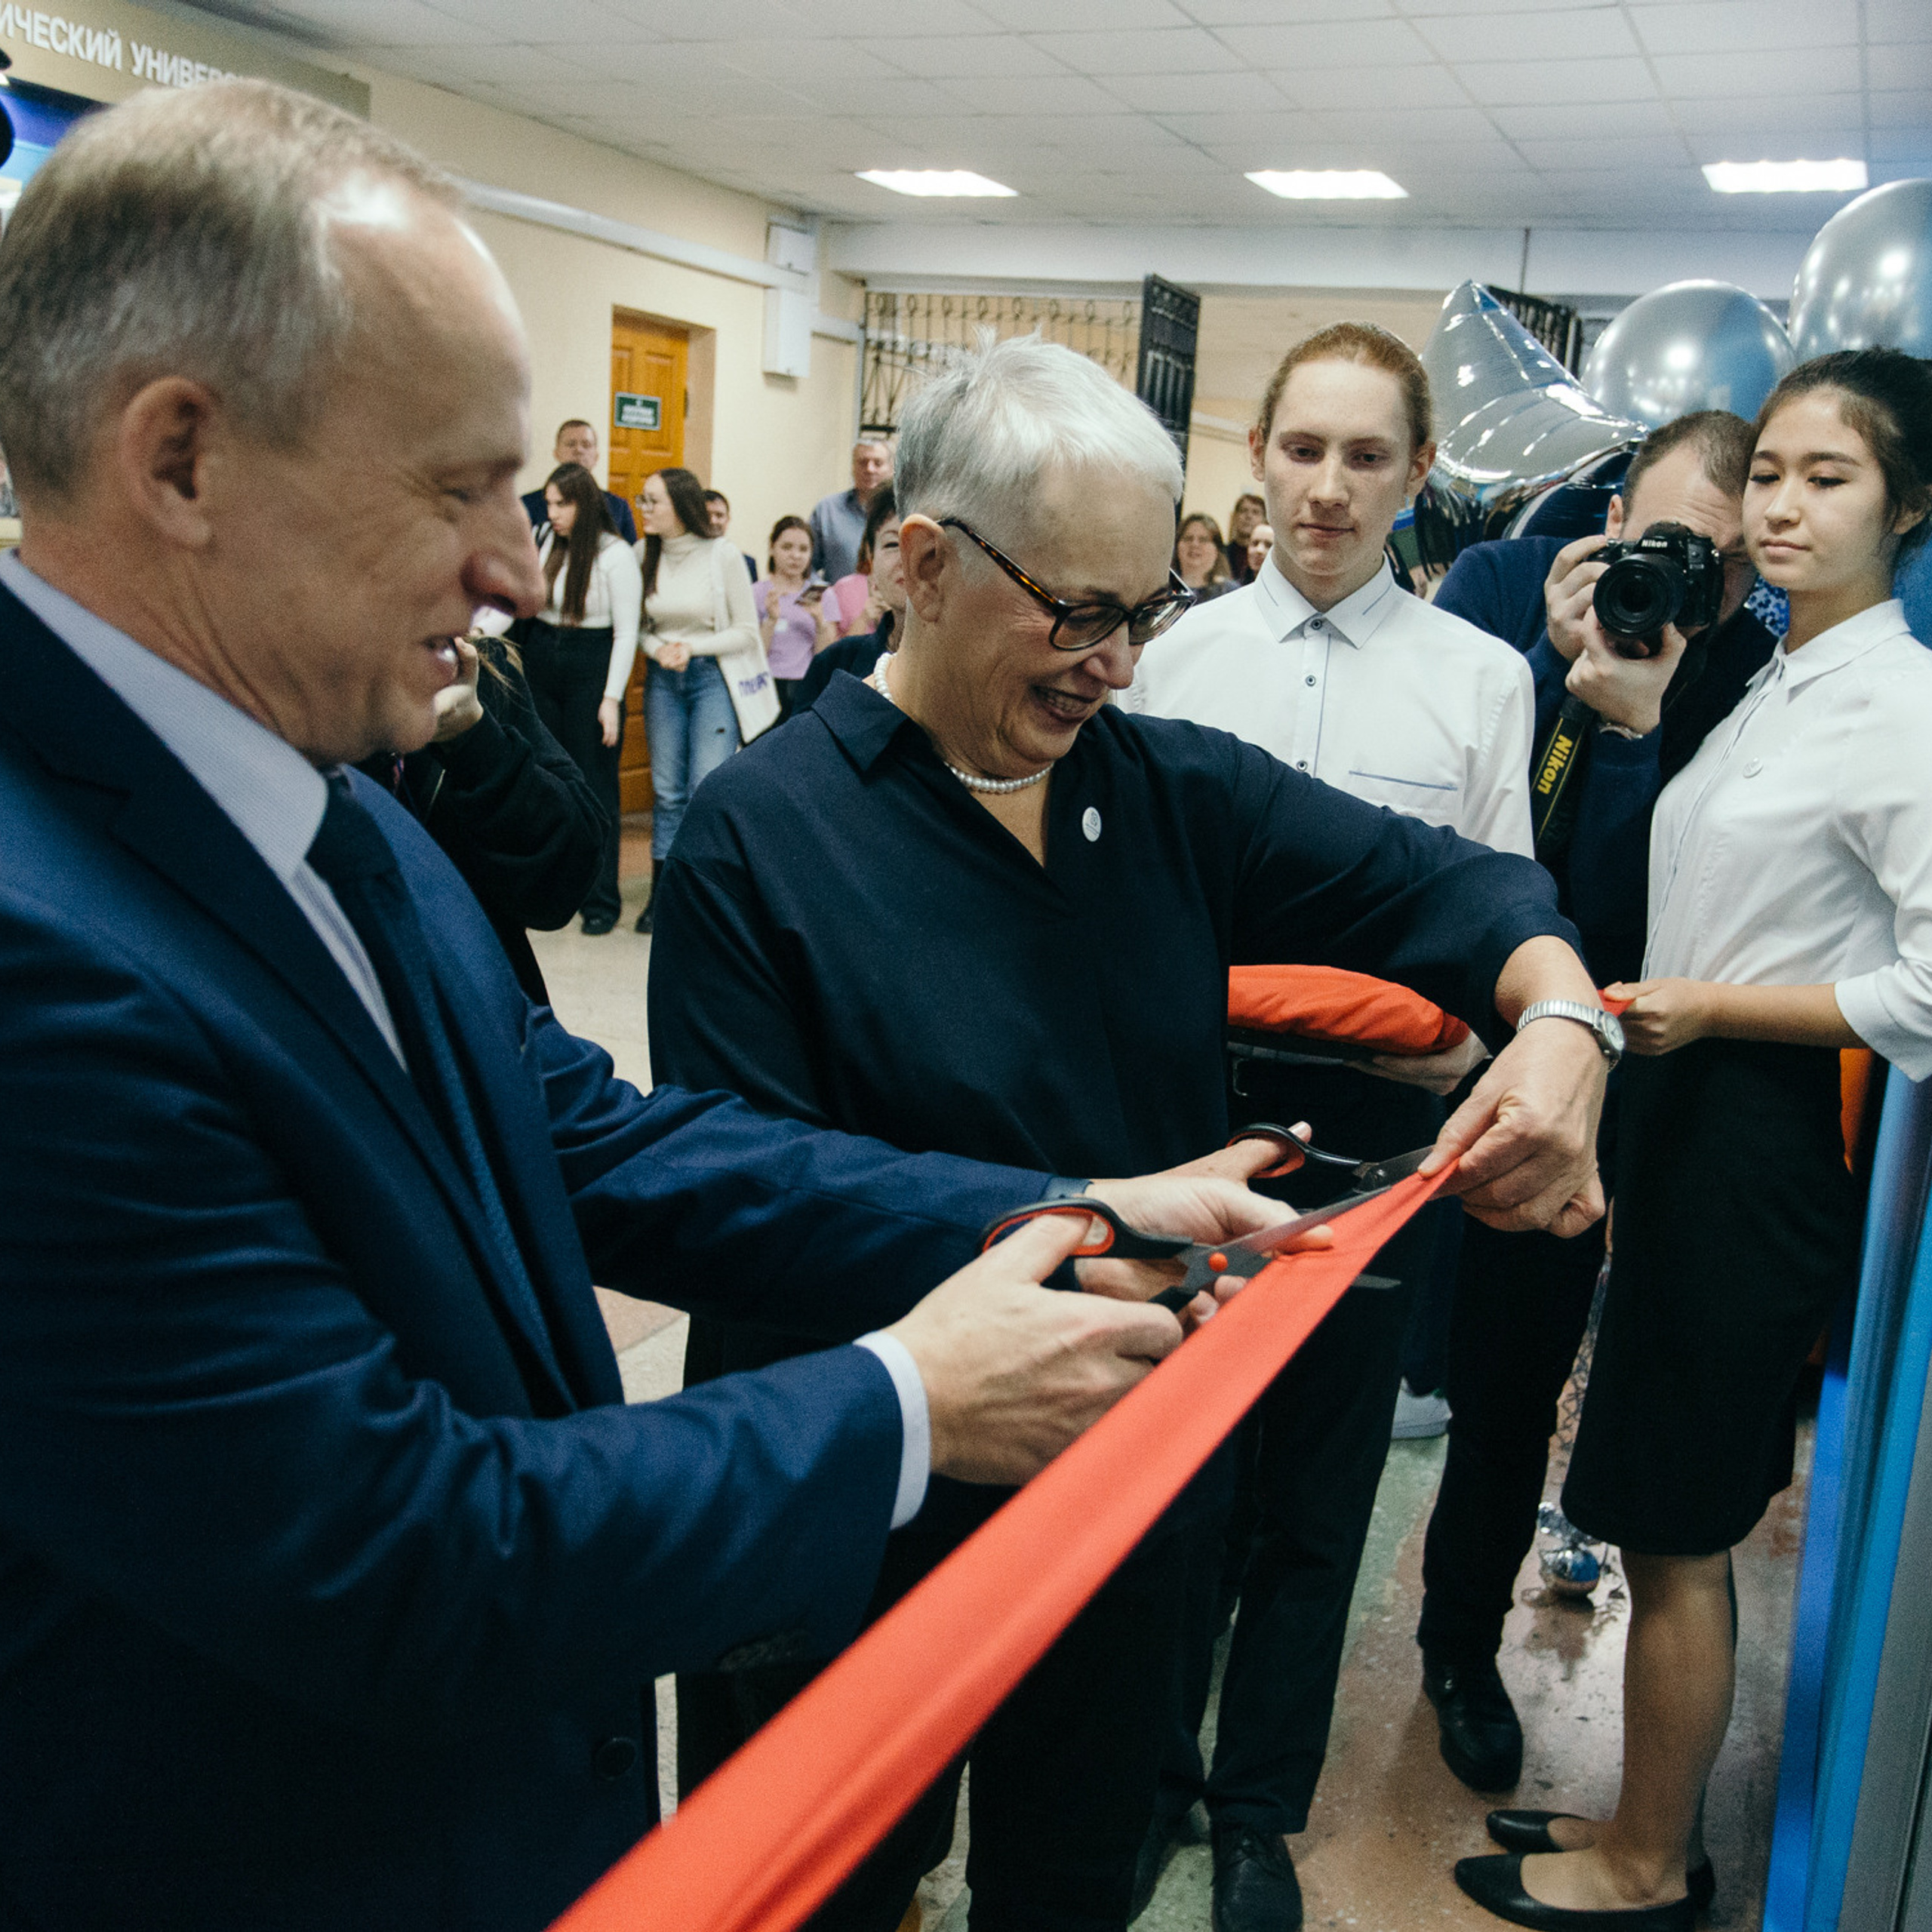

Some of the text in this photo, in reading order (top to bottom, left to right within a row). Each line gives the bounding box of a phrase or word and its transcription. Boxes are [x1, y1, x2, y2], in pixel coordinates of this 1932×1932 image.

[130, 41, 237, 89] УНИВЕ
[1641, 539, 1669, 549] Nikon
[1537, 734, 1574, 795] Nikon
